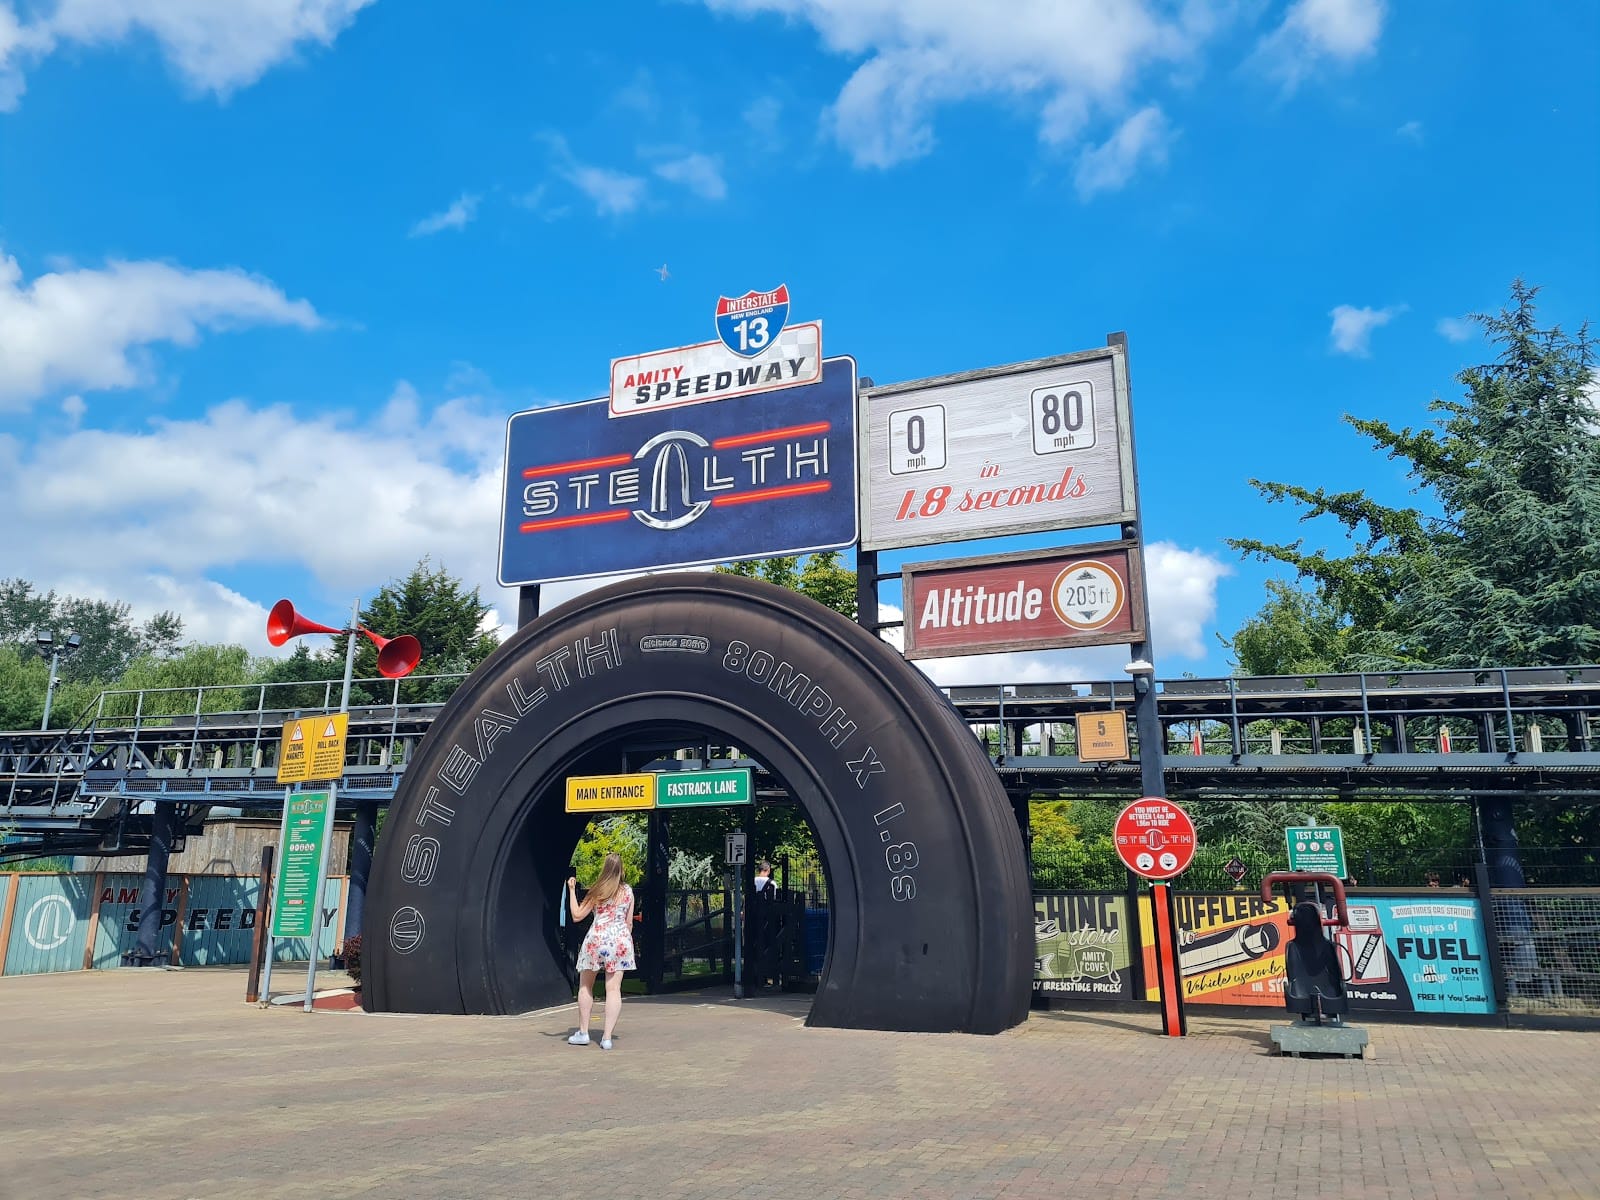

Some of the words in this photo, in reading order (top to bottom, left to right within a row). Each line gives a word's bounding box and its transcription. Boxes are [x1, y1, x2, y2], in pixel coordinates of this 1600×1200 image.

[727, 292, 777, 312] INTERSTATE
[746, 307, 773, 317] ENGLAND
[733, 317, 769, 350] 13
[624, 366, 684, 388] AMITY
[635, 357, 805, 404] SPEEDWAY
[1042, 390, 1083, 435] 80
[907, 415, 925, 454] 0
[1054, 434, 1074, 449] mph
[907, 455, 926, 469] mph
[980, 459, 1001, 479] in
[895, 485, 953, 521] 1.8
[953, 466, 1094, 513] seconds
[920, 580, 1042, 630] Altitude
[723, 640, 857, 749] 80MPH
[1098, 721, 1106, 736] 5
[401, 628, 623, 886] STEALTH
[576, 788, 597, 800] MAIN
[601, 785, 644, 799] ENTRANCE
[667, 782, 711, 796] FASTRACK
[714, 780, 737, 794] LANE
[1295, 831, 1311, 839] TEST
[1314, 831, 1331, 839] SEAT
[101, 887, 181, 903] AMY
[125, 908, 338, 931] SPEEDY
[1446, 907, 1471, 916] STATION
[1068, 918, 1119, 945] store
[1419, 924, 1445, 934] types
[1448, 921, 1458, 932] of
[1082, 951, 1106, 961] AMITY
[1397, 937, 1481, 961] FUEL
[1085, 962, 1104, 972] COVE
[1043, 981, 1091, 992] IRRESISTIBLE
[1093, 983, 1122, 992] PRICES!
[1186, 973, 1231, 994] Vehicle
[1234, 970, 1254, 985] use
[1355, 991, 1368, 999] Per
[1370, 991, 1397, 1000] Gallon
